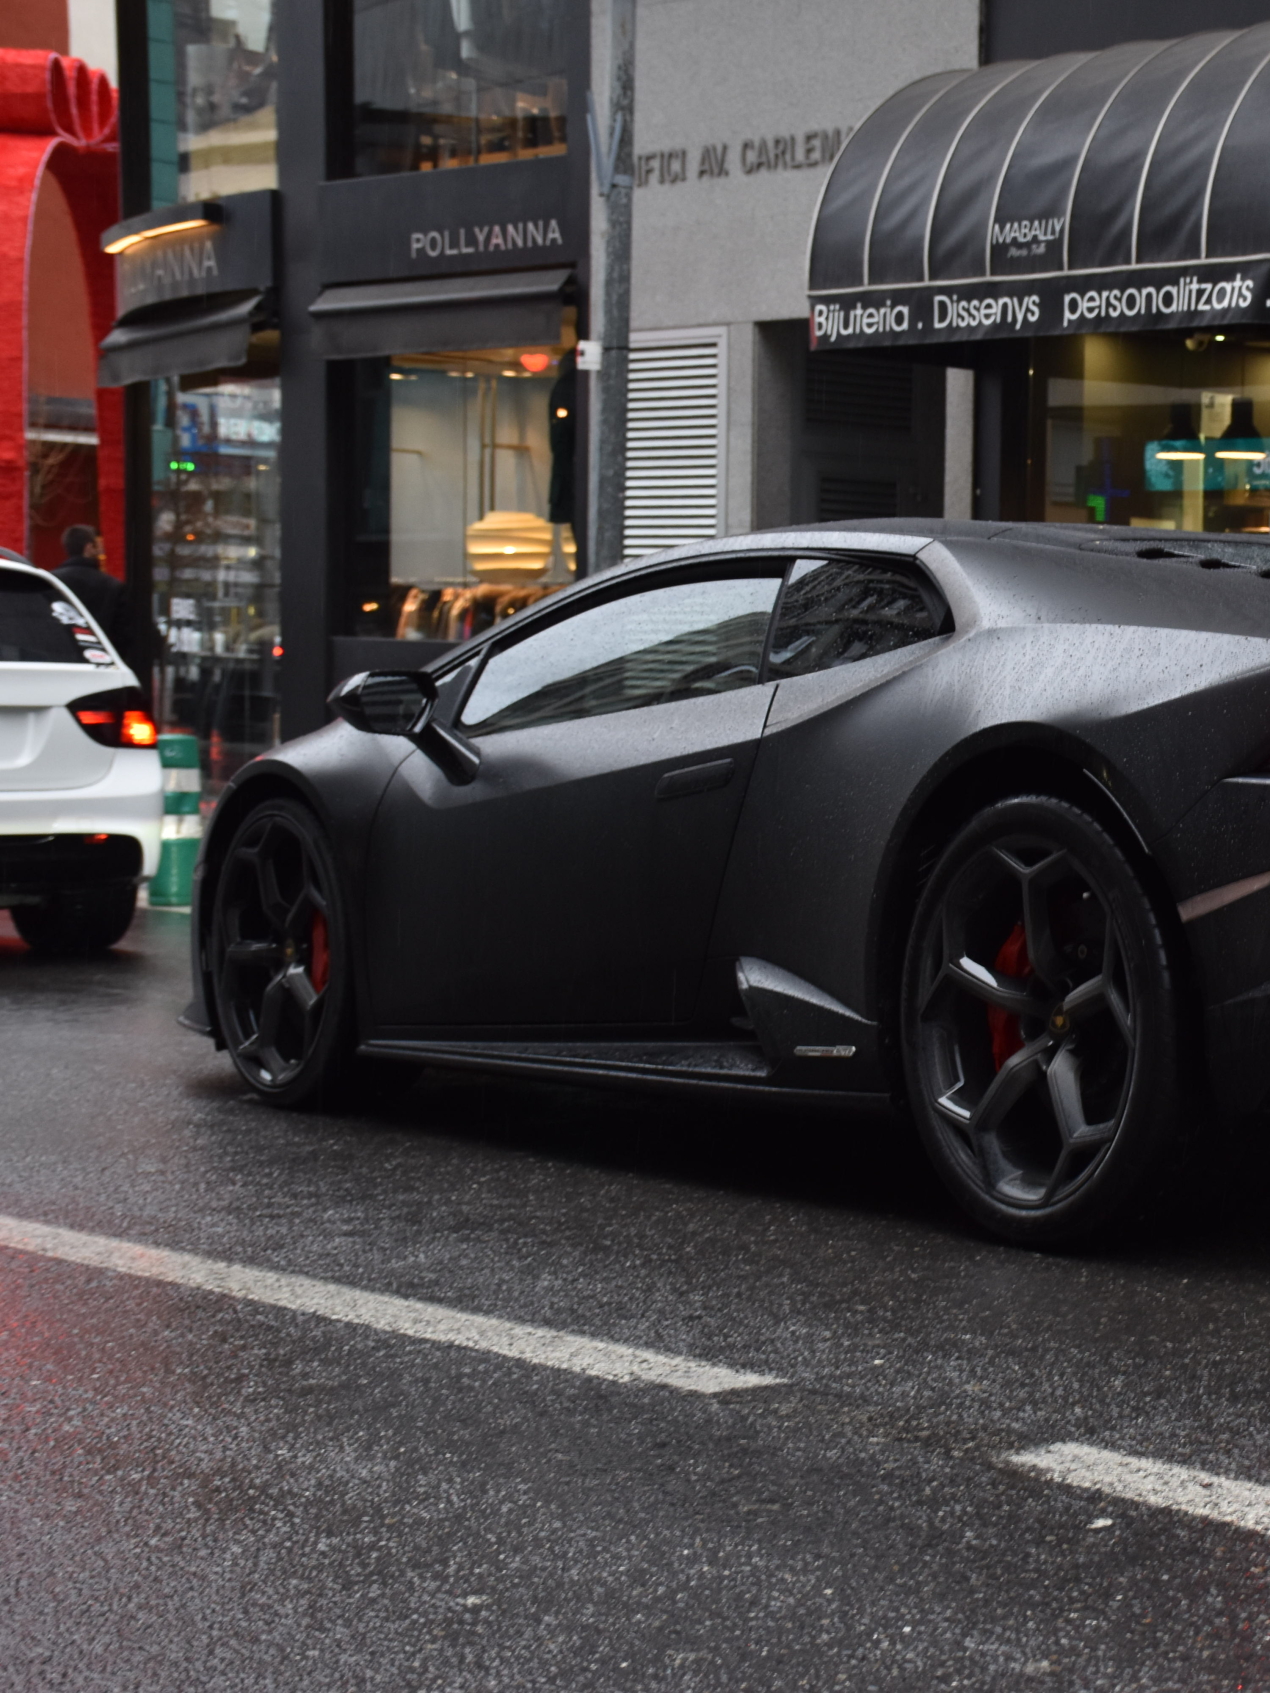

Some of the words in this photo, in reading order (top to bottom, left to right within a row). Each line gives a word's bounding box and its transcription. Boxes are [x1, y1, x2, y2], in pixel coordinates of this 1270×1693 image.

[697, 142, 730, 180] AV.
[740, 124, 853, 176] CARLEM
[410, 218, 563, 259] POLLYANNA
[992, 216, 1065, 245] MABALLY
[814, 300, 909, 342] Bijuteria
[933, 294, 1041, 331] Dissenys
[1062, 272, 1254, 328] personalitzats
